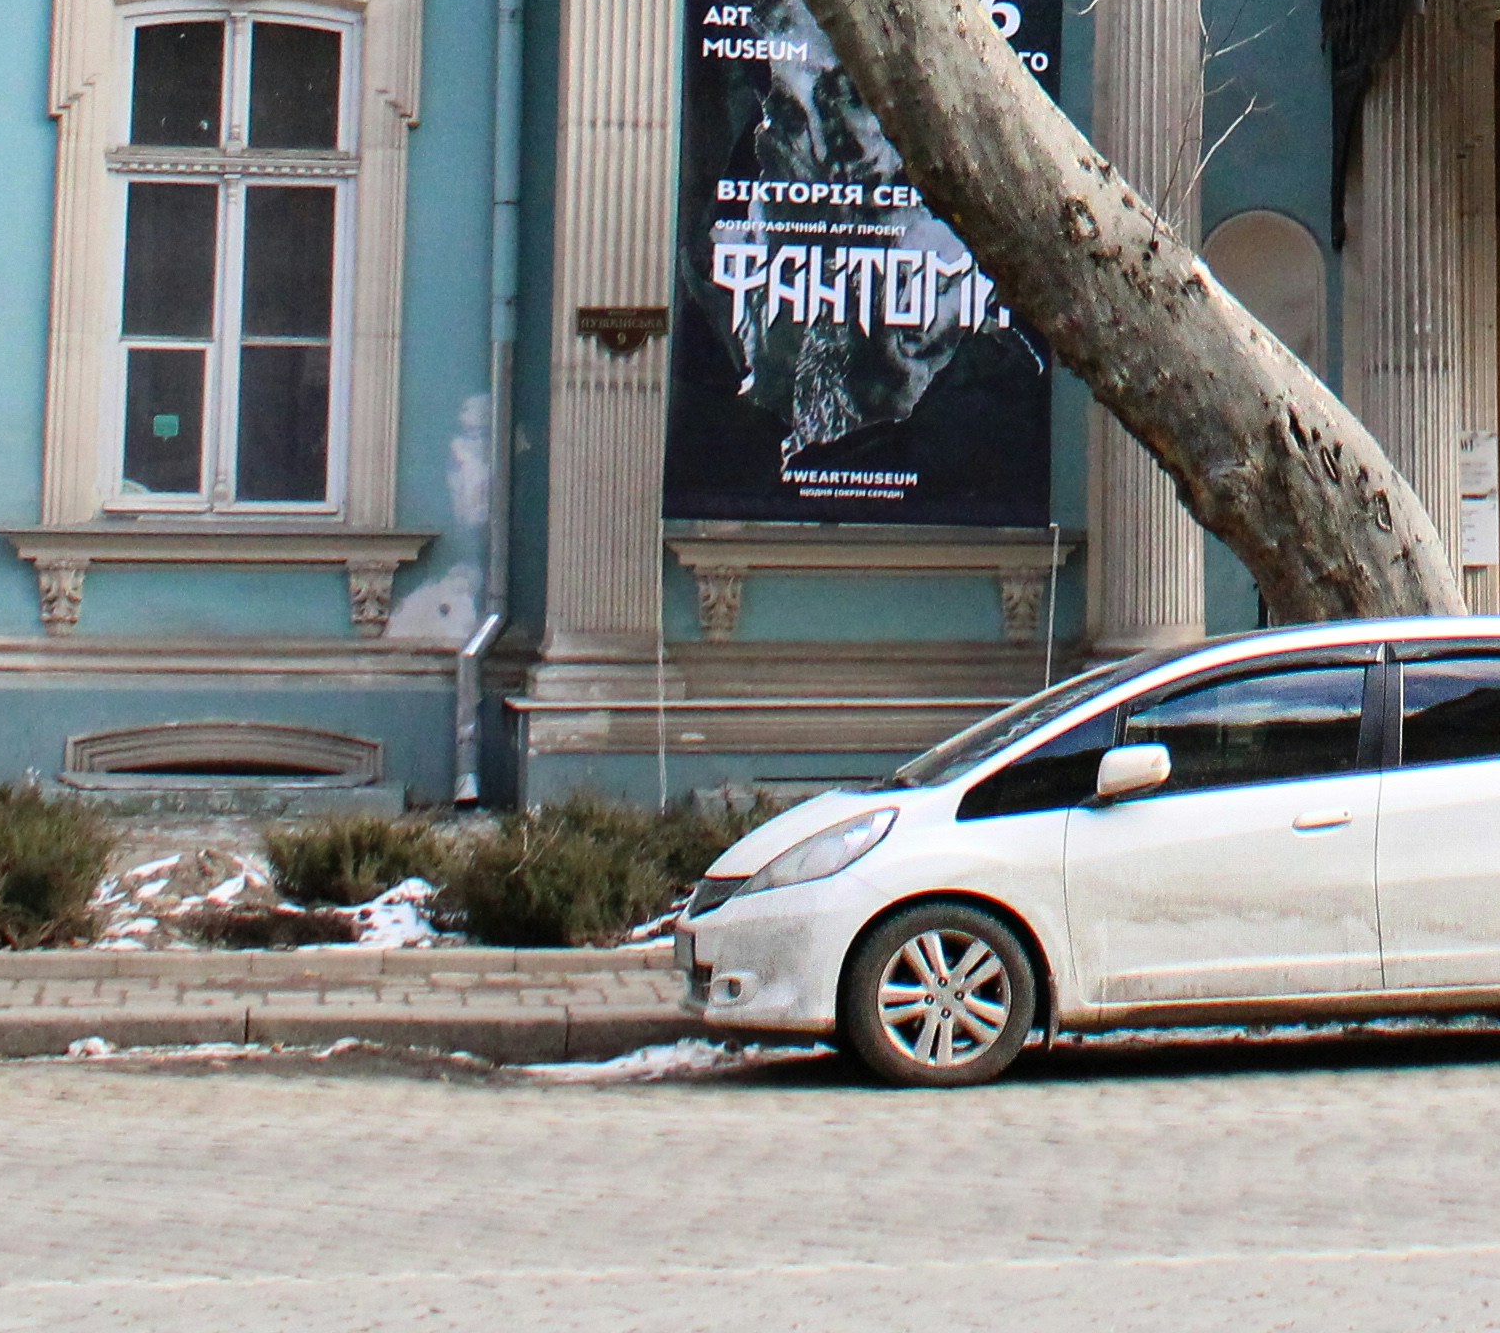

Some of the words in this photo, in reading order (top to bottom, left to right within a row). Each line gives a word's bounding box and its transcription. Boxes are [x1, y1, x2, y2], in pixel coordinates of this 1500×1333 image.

[702, 5, 752, 27] ART
[702, 37, 808, 62] MUSEUM
[716, 179, 863, 206] ВІКТОРІЯ
[714, 218, 827, 234] ФОТОГРАФІЧНИЙ
[830, 222, 855, 235] АРТ
[857, 223, 908, 237] ПРОЕКТ
[782, 469, 919, 486] #WEARTMUSEUM
